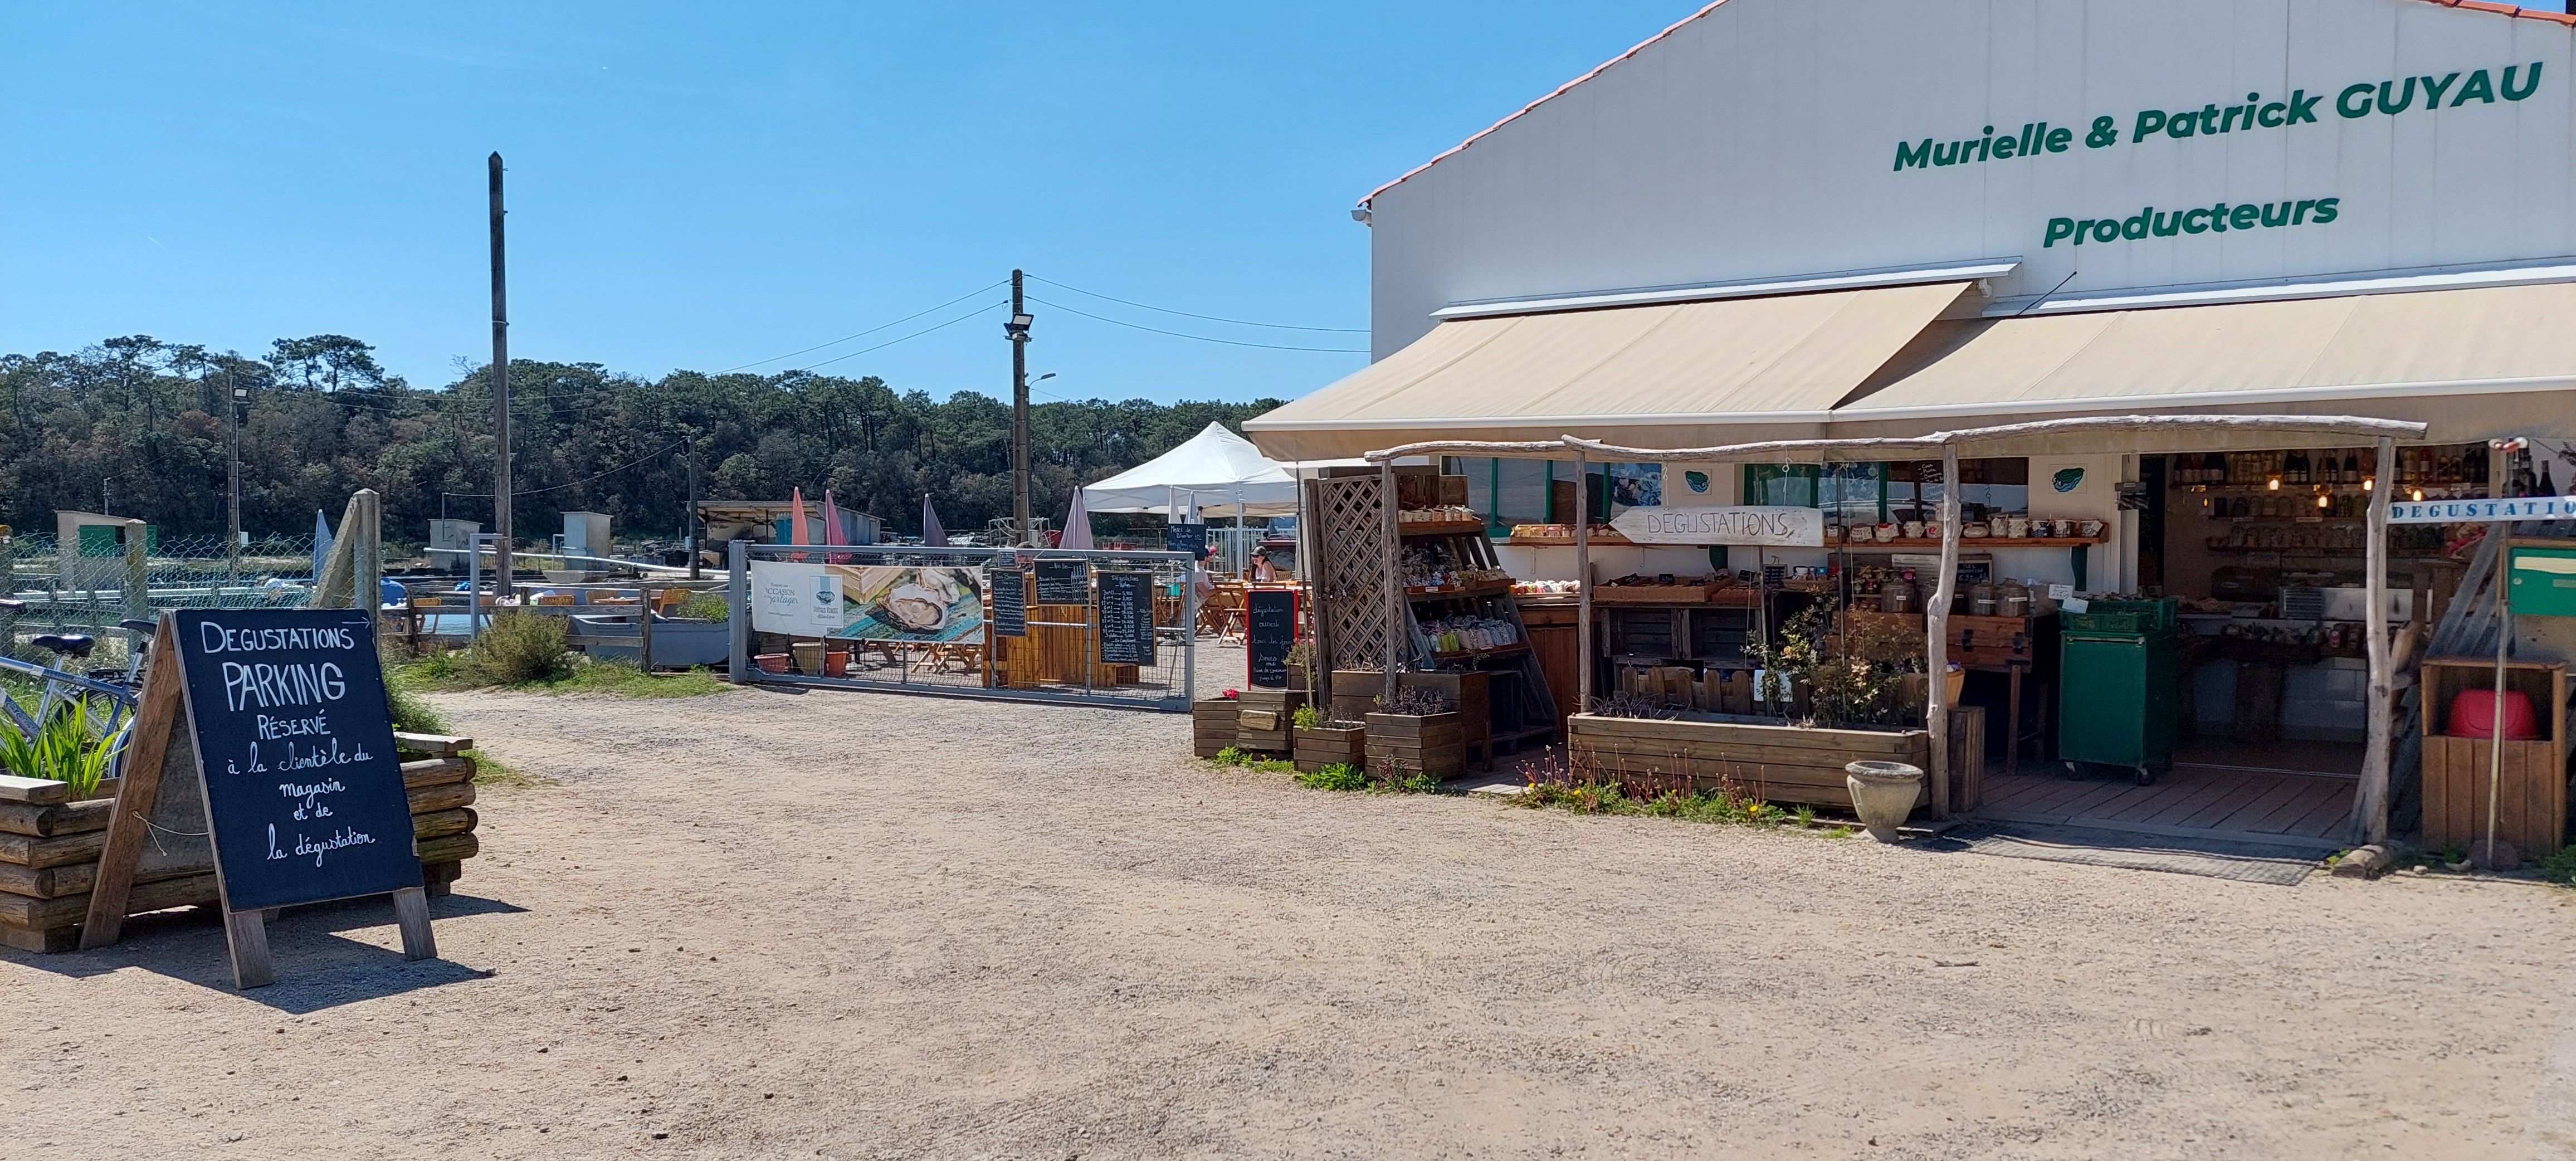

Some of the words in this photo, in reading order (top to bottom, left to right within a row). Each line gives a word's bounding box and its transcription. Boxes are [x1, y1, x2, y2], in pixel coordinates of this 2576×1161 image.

[1894, 122, 2073, 172] Murielle
[2085, 115, 2118, 149] &
[2133, 89, 2321, 143] Patrick
[2336, 61, 2543, 118] GUYAU
[2043, 197, 2339, 248] Producteurs
[1647, 511, 1788, 536] DEGUSTATIONS
[1252, 603, 1283, 617] dégustation
[201, 621, 355, 653] DEGUSTATIONS
[222, 662, 346, 712] PARKING
[257, 709, 331, 740] RÉSERVÉ
[227, 759, 240, 774] à
[248, 742, 267, 773] la
[277, 737, 352, 771] clientèle
[354, 743, 374, 762] du
[279, 778, 345, 809] magasin
[293, 803, 308, 821] et
[315, 802, 333, 817] de
[267, 823, 288, 860] la
[295, 826, 376, 867] dégustation
